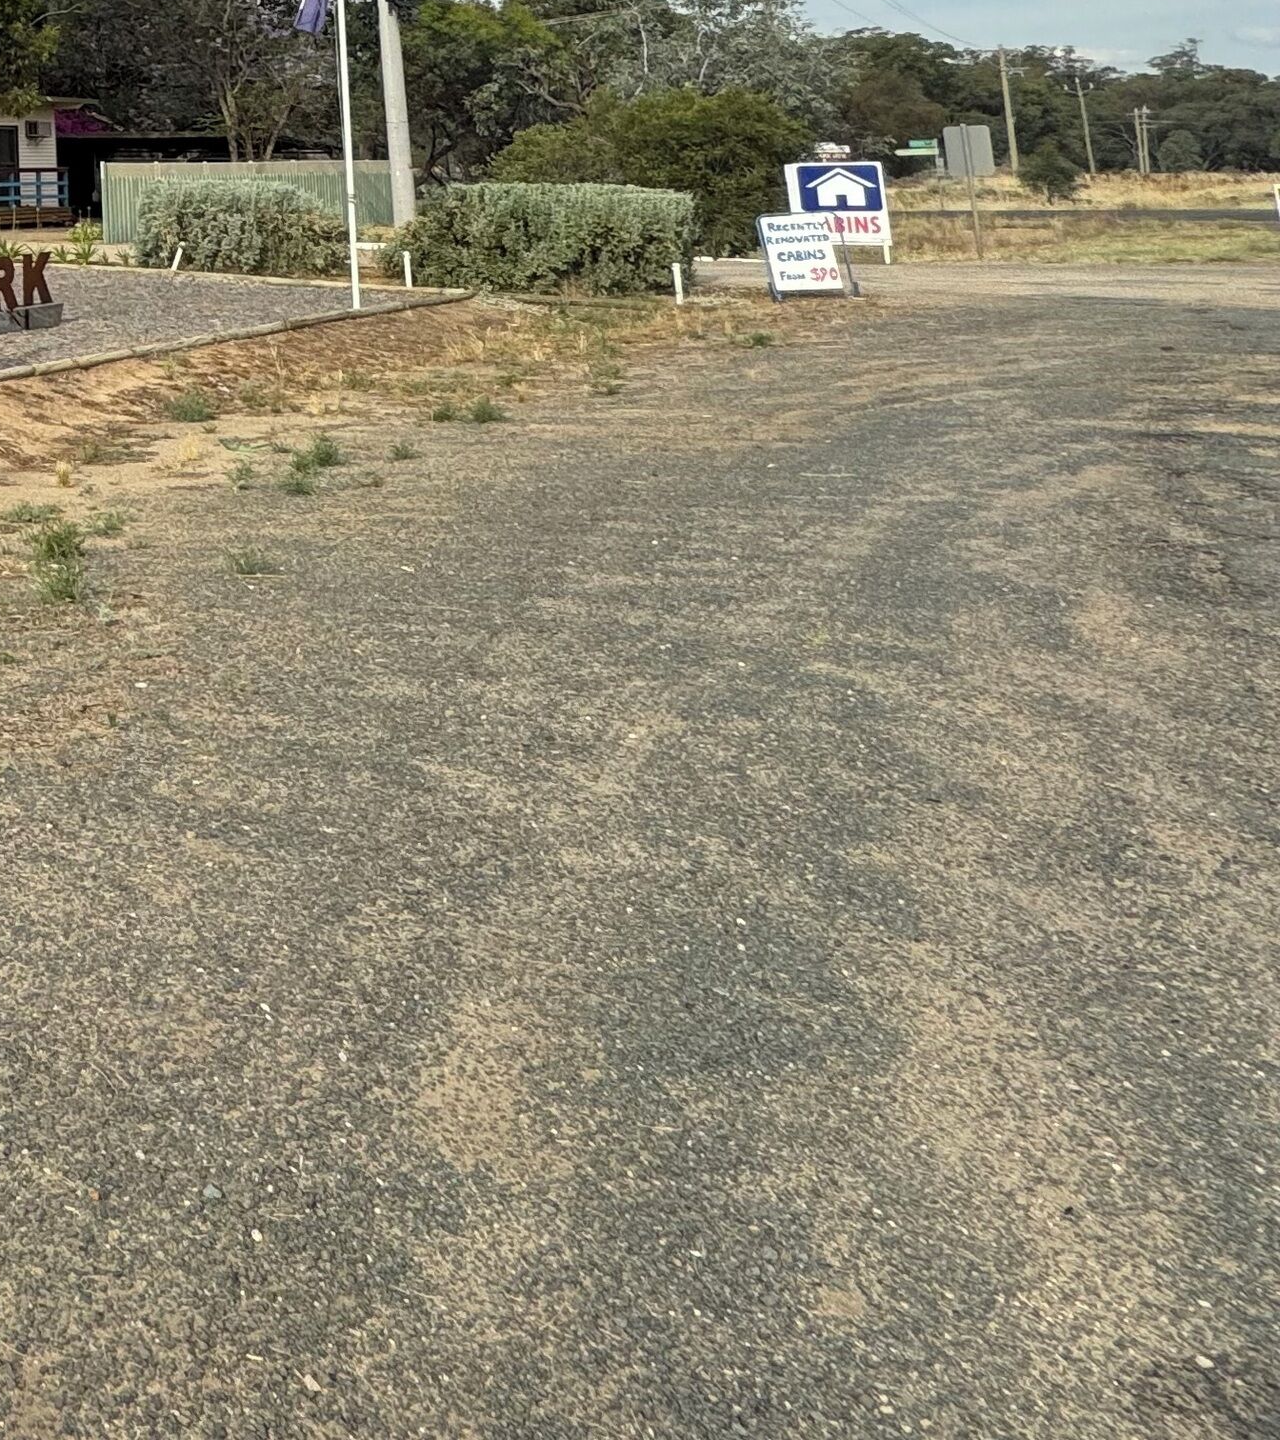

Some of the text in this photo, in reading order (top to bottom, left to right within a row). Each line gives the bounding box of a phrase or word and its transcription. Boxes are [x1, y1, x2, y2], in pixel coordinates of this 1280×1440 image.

[825, 216, 881, 233] BINS
[766, 234, 829, 245] RENOVATED
[777, 249, 826, 262] CABINS
[810, 267, 838, 282] $90
